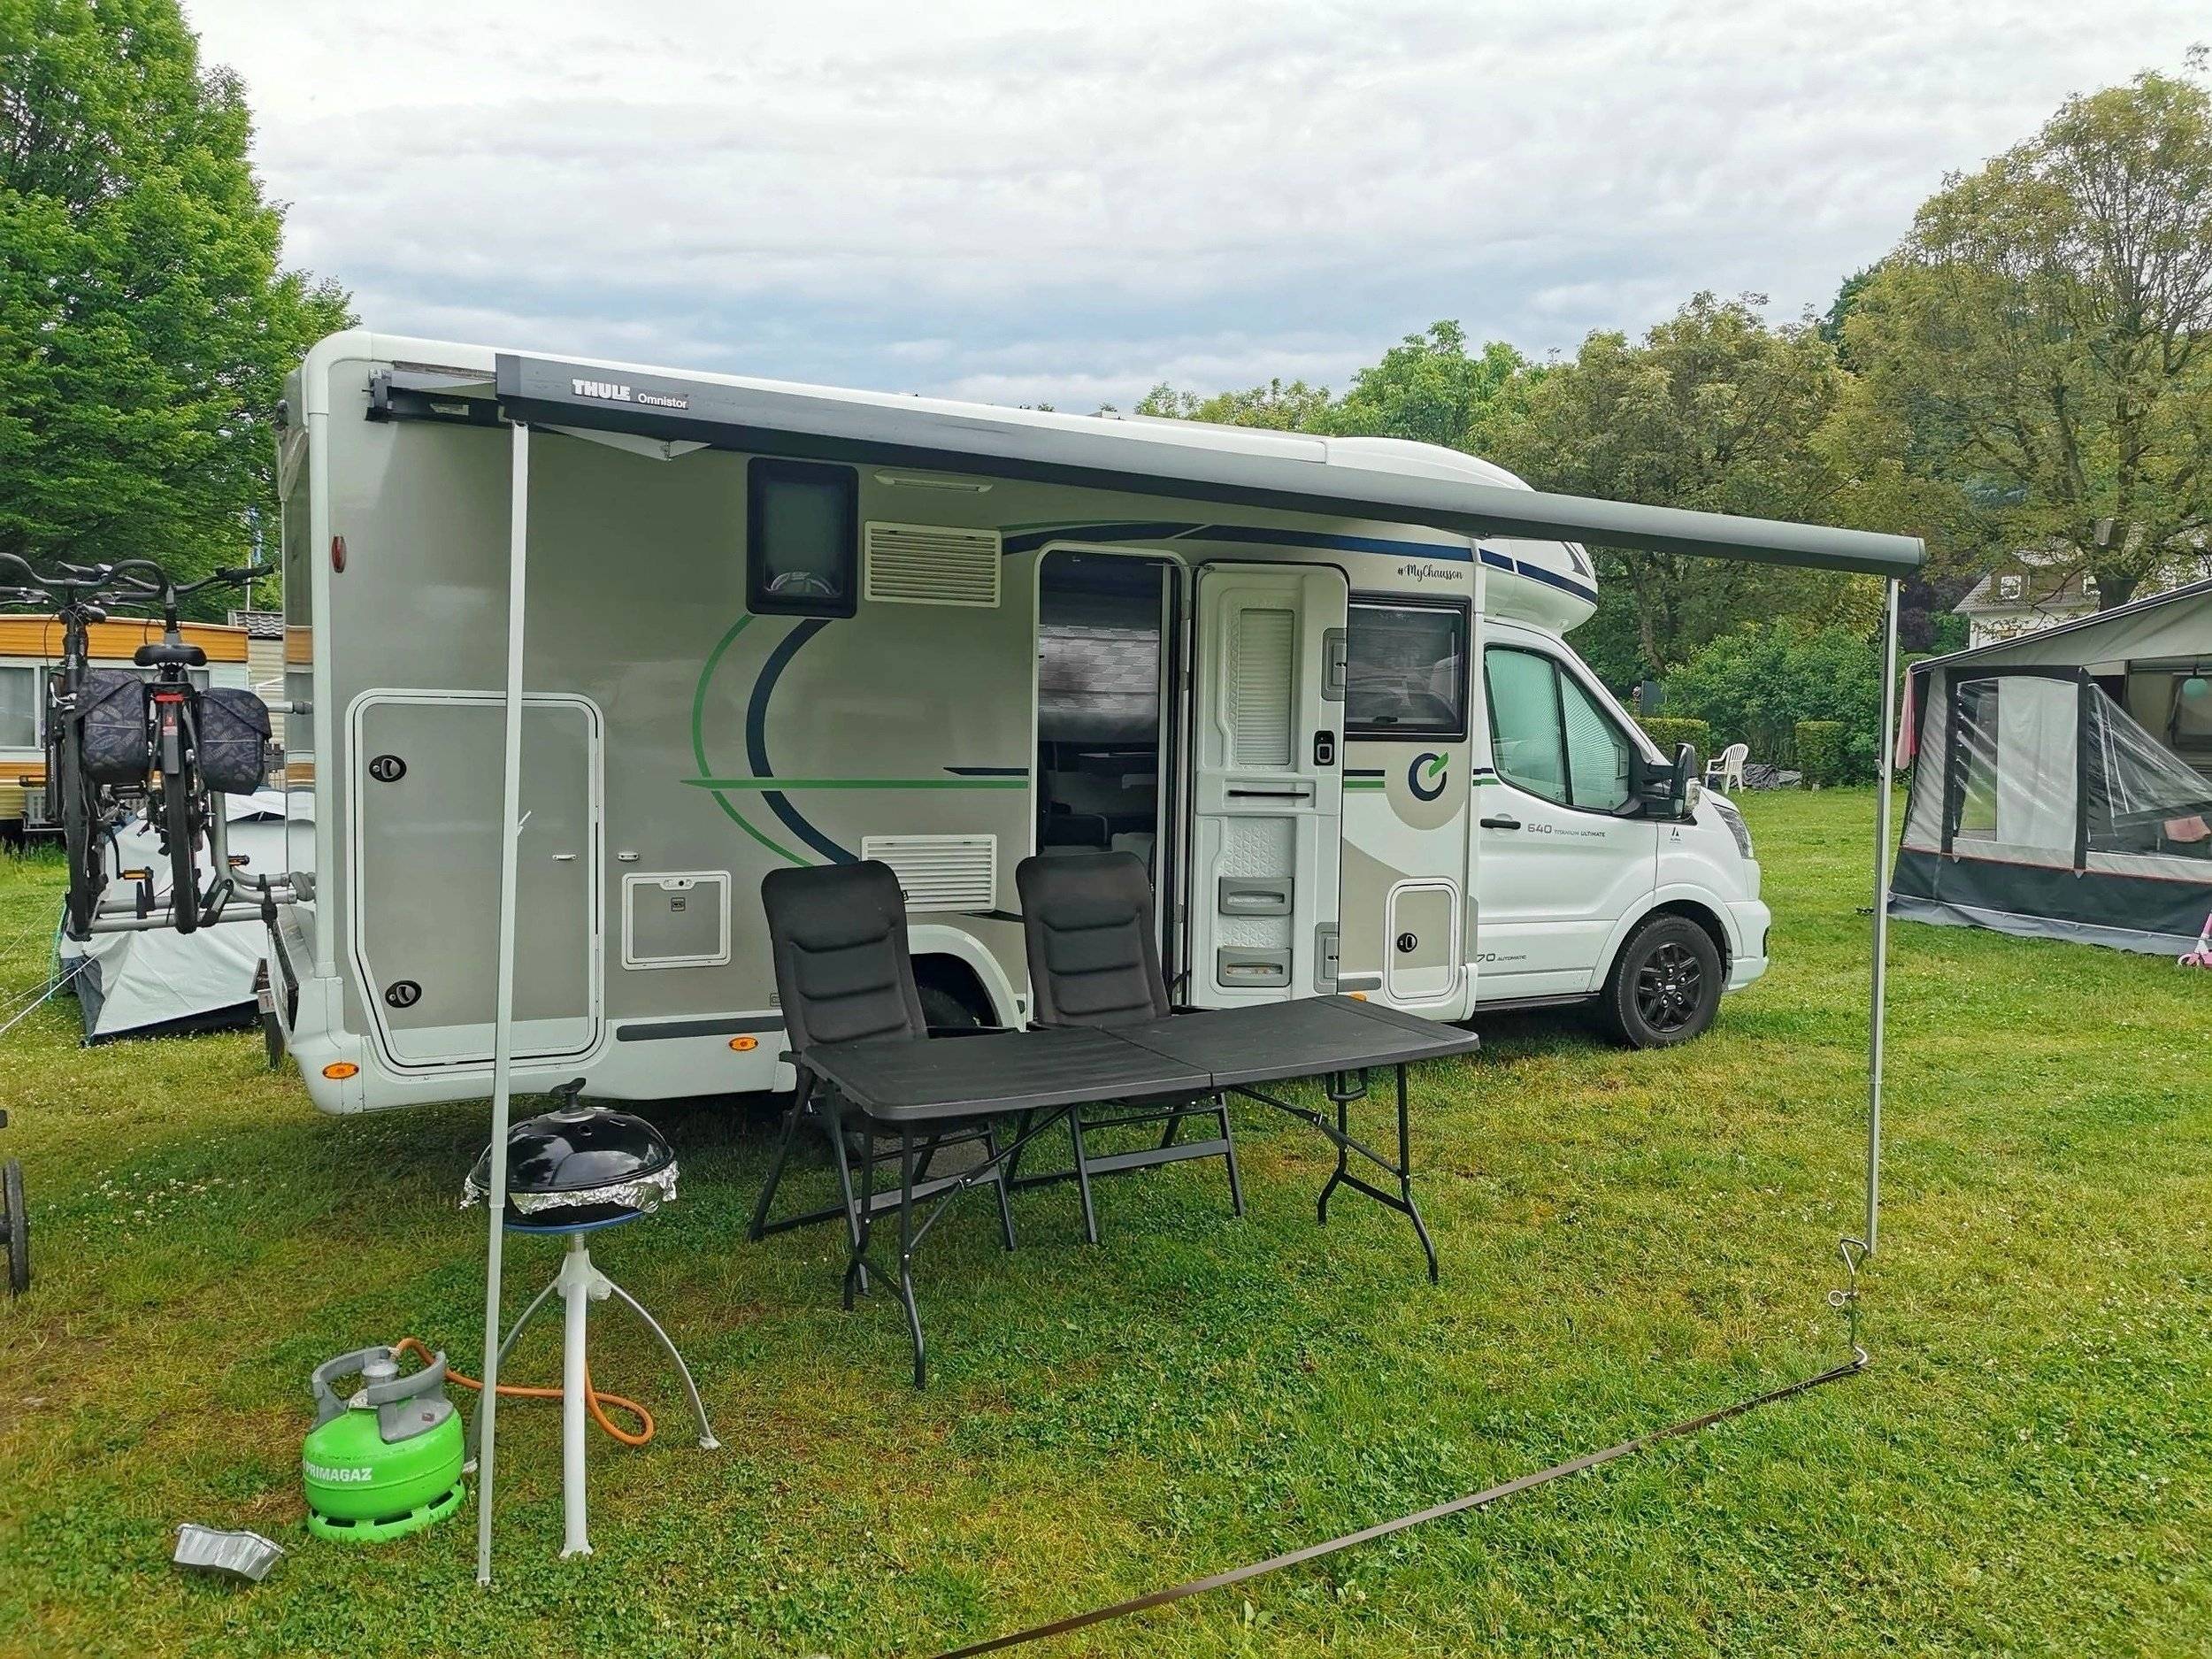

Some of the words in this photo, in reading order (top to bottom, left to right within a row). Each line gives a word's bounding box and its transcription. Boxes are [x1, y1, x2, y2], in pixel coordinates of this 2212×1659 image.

[572, 379, 631, 402] THULE
[637, 393, 688, 410] Omnistor
[1397, 564, 1463, 582] #MyChausson
[1527, 823, 1553, 834] 640
[305, 1460, 373, 1482] PRIMAGAZ
